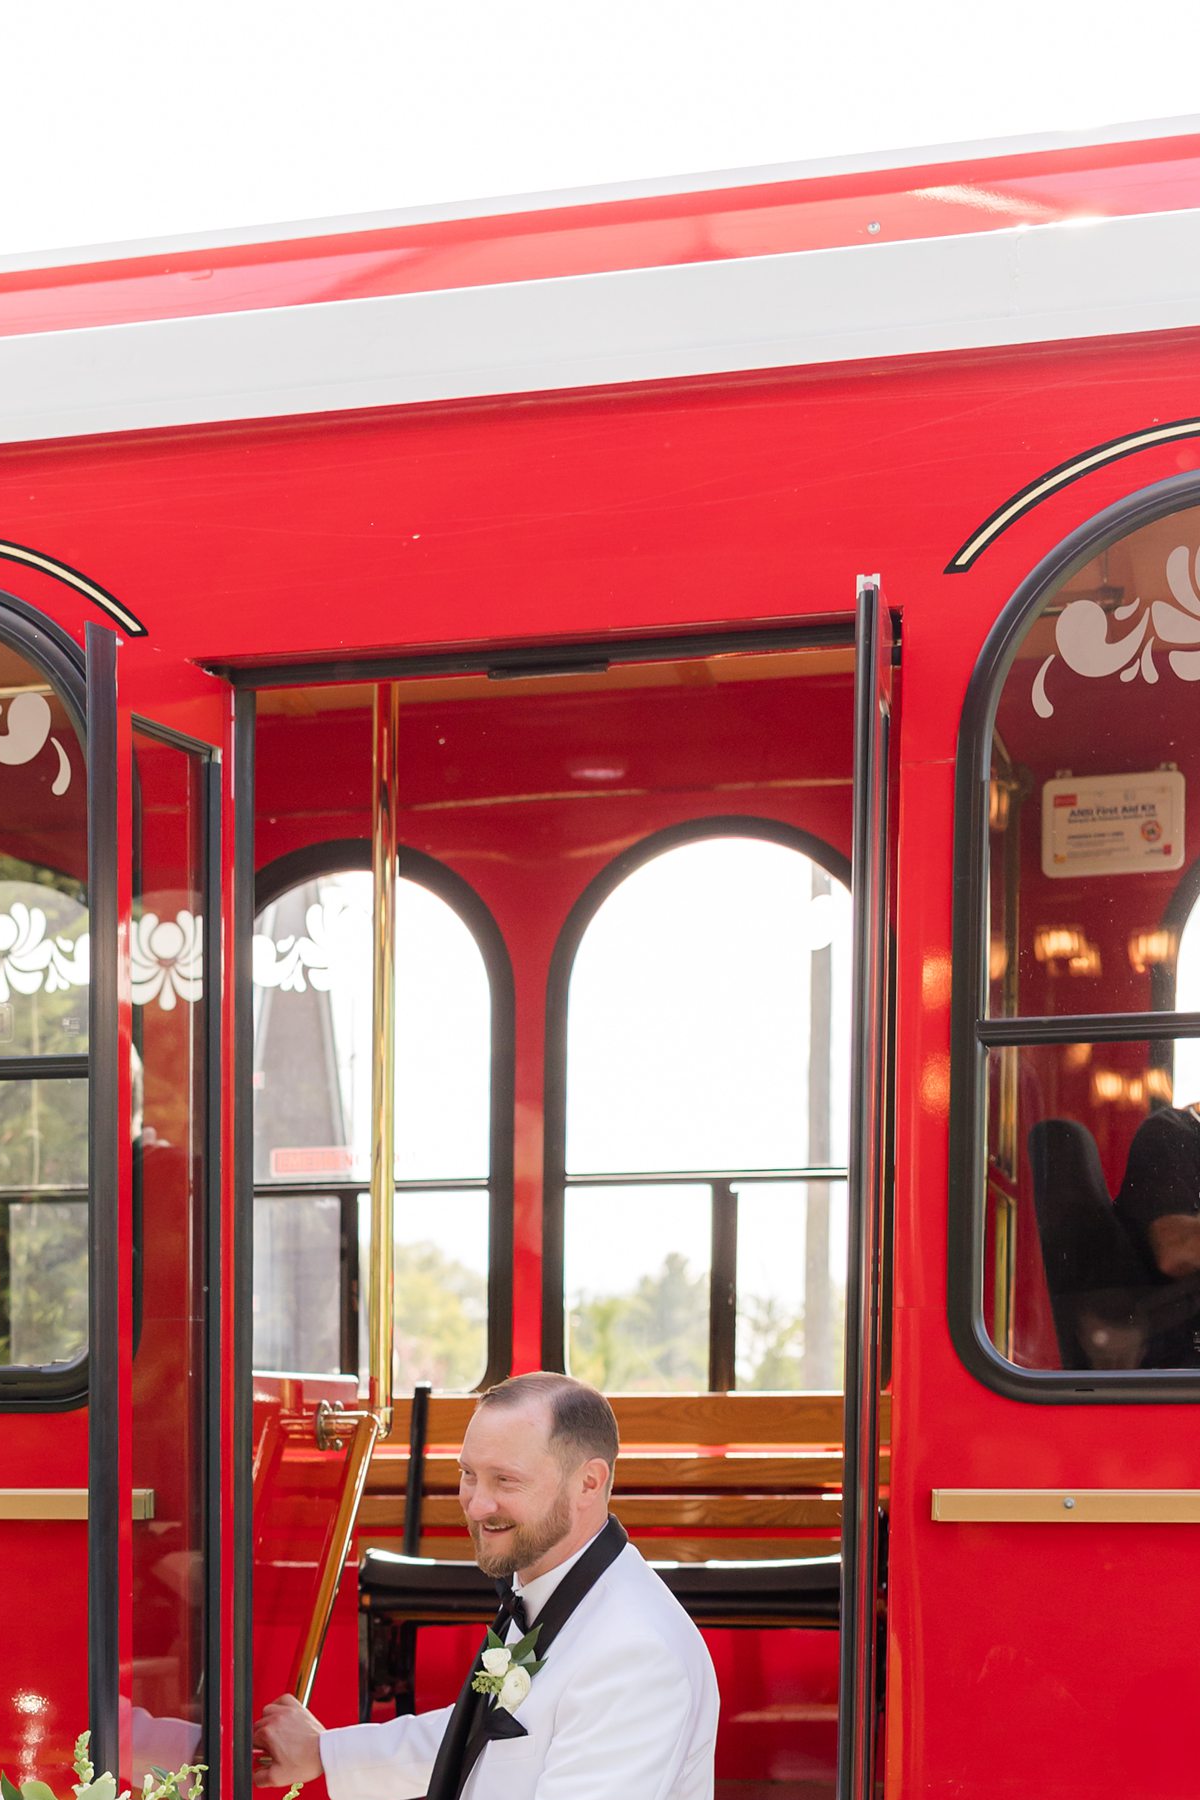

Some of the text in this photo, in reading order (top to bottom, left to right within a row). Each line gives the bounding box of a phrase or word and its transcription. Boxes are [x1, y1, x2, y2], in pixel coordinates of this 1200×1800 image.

[1096, 806, 1118, 816] First
[1122, 804, 1139, 814] Aid
[1141, 803, 1156, 812] Kit
